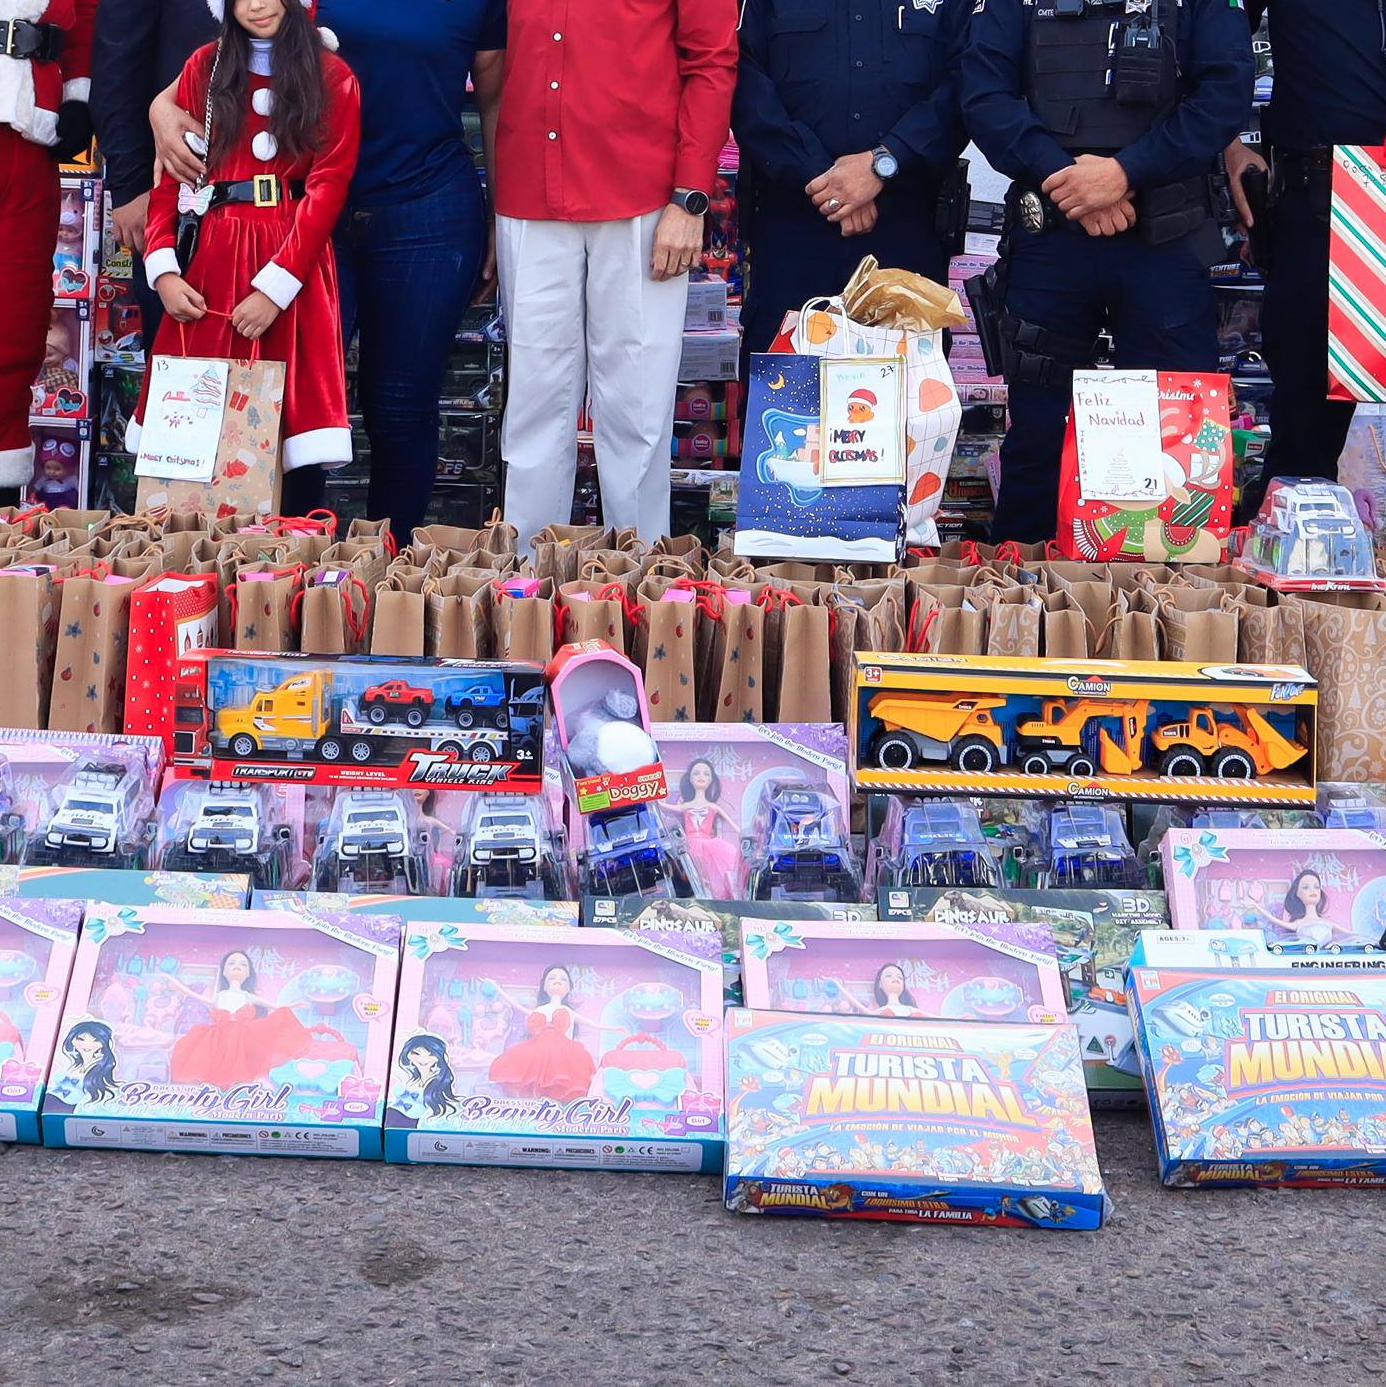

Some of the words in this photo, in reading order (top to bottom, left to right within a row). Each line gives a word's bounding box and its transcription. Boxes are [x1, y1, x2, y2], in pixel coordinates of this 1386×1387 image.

[880, 366, 894, 379] 27
[1076, 391, 1112, 407] Feliz
[1144, 478, 1158, 490] 21
[1067, 675, 1111, 692] CAMION
[516, 749, 533, 760] 3+
[410, 753, 512, 783] TRUCK
[609, 781, 658, 802] Doggy
[1067, 781, 1110, 798] CAMION
[1123, 897, 1151, 913] 3D
[935, 909, 1013, 924] DINOSAUR
[640, 919, 716, 932] DINOSAUR
[1285, 990, 1356, 1005] ORIGINAL
[884, 1035, 957, 1050] ORIGINAL
[834, 1052, 990, 1083] TURISTA
[120, 1083, 224, 1119] Beauty
[219, 1082, 293, 1112] Girl
[805, 1078, 1037, 1128] MUNDIAL
[1256, 1096, 1268, 1105] LA
[1315, 1092, 1325, 1101] DE
[1327, 1092, 1363, 1102] VIAJAR
[1365, 1093, 1384, 1102] POR
[462, 1096, 568, 1131] Beauty
[563, 1096, 633, 1124] Girl
[892, 1123, 904, 1131] DE
[907, 1123, 943, 1134] VIAJAR
[947, 1126, 967, 1136] POR
[970, 1129, 980, 1137] EL
[1197, 1170, 1263, 1181] MUNDIAL
[771, 1184, 818, 1194] TURISTA
[760, 1193, 831, 1209] MUNDIAL
[919, 1210, 931, 1218] LA
[934, 1210, 973, 1219] FAMILIA
